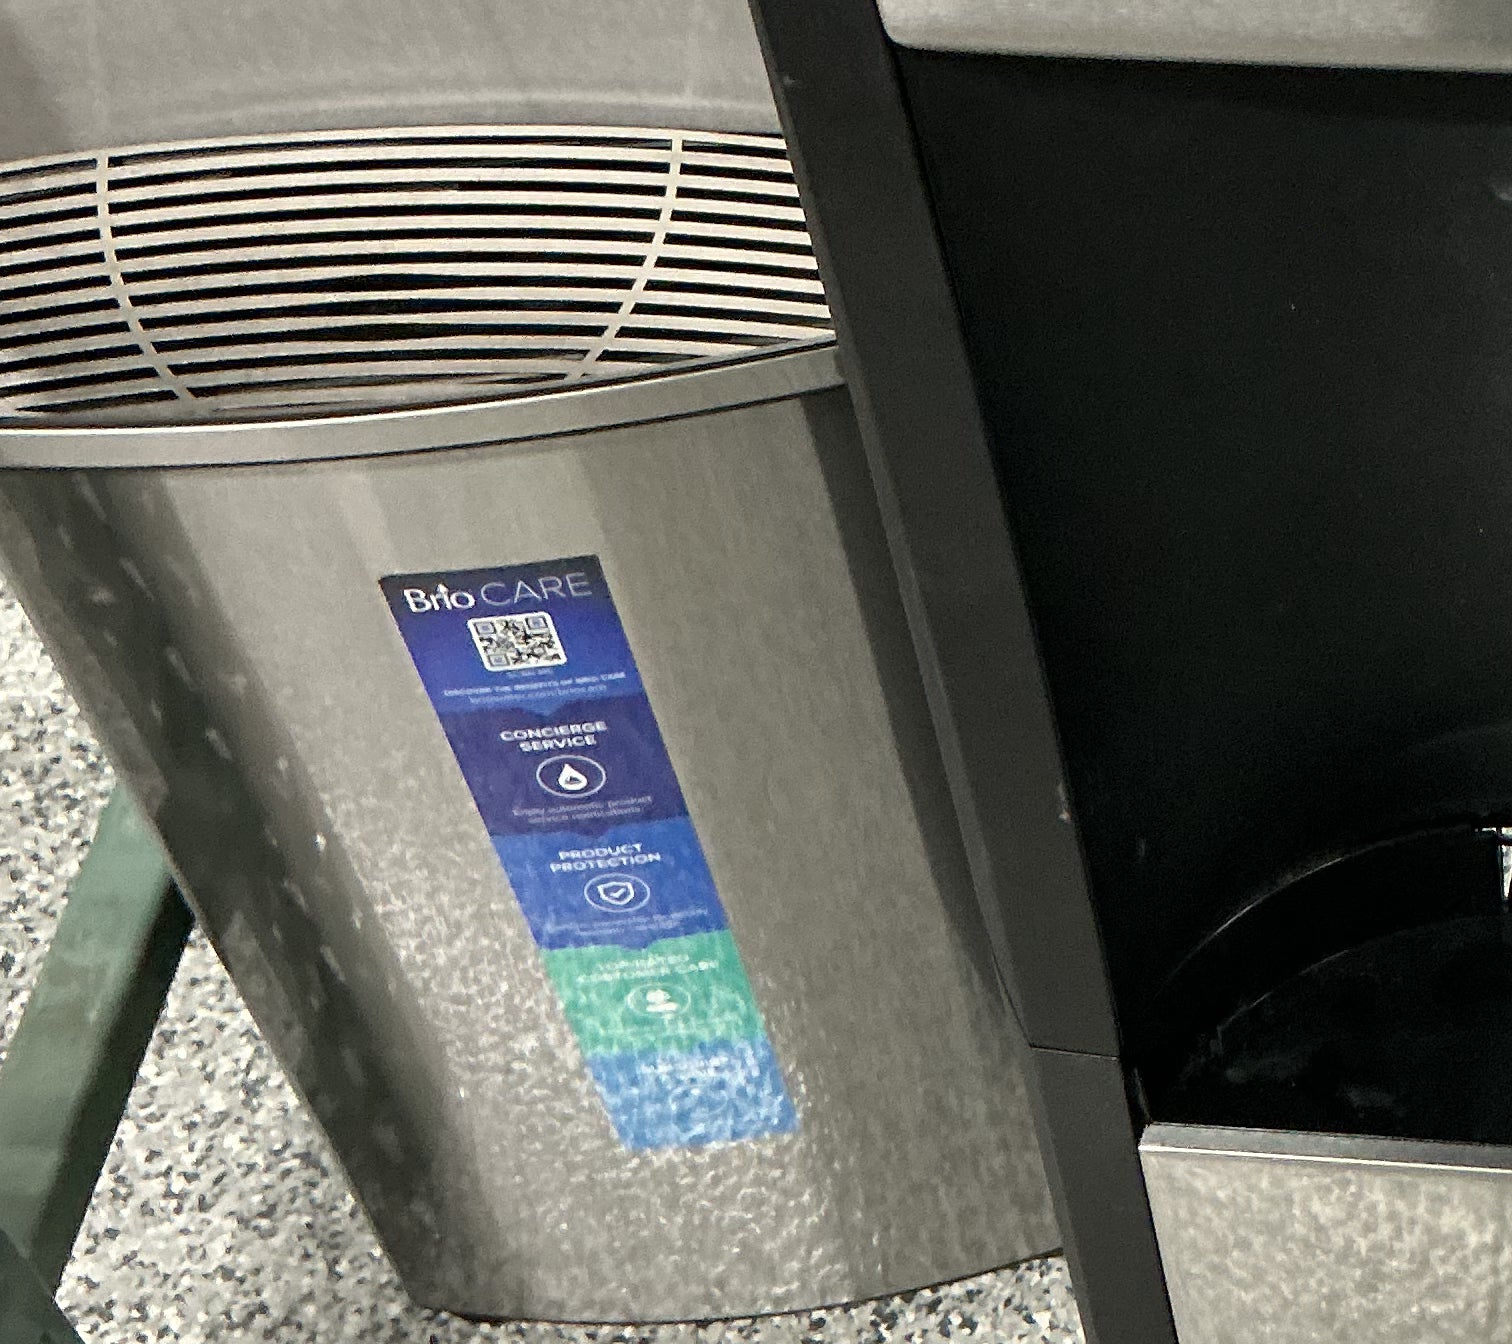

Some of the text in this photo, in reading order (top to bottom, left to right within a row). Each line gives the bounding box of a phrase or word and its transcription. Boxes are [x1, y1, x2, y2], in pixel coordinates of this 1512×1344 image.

[403, 571, 593, 613] Brio CARE
[500, 721, 608, 742] CONCIERGE
[519, 734, 597, 753] SERVICE
[558, 842, 643, 861] PRODUCT
[549, 852, 661, 873] PROTECTION
